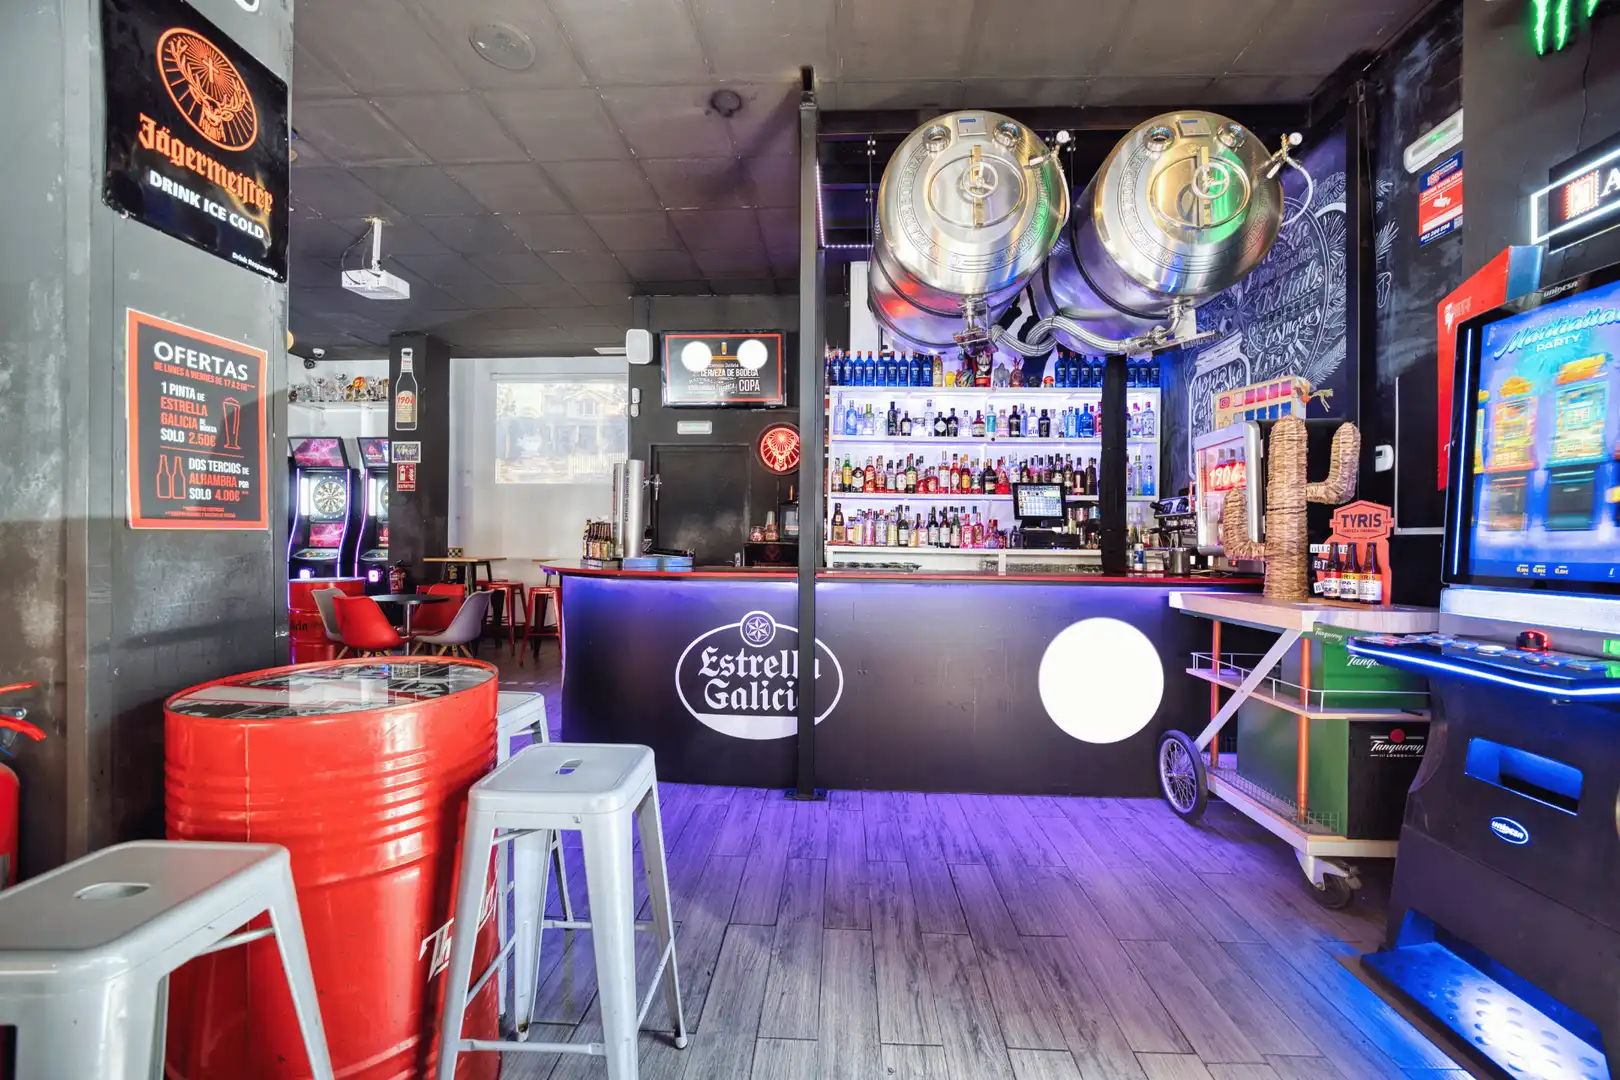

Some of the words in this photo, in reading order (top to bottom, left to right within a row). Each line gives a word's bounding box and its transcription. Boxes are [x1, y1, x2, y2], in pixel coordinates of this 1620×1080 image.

[138, 112, 274, 213] Jägermeister
[149, 170, 200, 209] DRINK
[203, 198, 227, 222] ICE
[229, 213, 265, 239] COLD
[1494, 308, 1620, 360] Manhatta
[1536, 333, 1580, 352] PARTY
[154, 341, 249, 381] OFERTAS
[164, 363, 185, 376] LUNES
[701, 369, 726, 377] CERVEZA
[727, 369, 735, 377] DE
[736, 369, 760, 377] BODEGA
[161, 381, 167, 395] 1
[169, 382, 196, 400] PINTA
[196, 392, 206, 402] DE
[739, 380, 761, 392] COPA
[160, 396, 208, 416] ESTRELLA
[160, 412, 198, 430] GALICIA
[160, 428, 185, 443] SOLO
[187, 431, 217, 447] 2.50€
[188, 457, 207, 471] DOS
[207, 460, 242, 475] TERCIOS
[241, 467, 250, 475] DE
[1209, 461, 1241, 487] 1906
[189, 472, 238, 488] ALHAMBRA
[238, 480, 250, 489] POR
[188, 487, 212, 501] SOLO
[1341, 513, 1382, 528] TYRIS
[704, 678, 799, 711] Galici
[1370, 740, 1424, 754] Tanqueray
